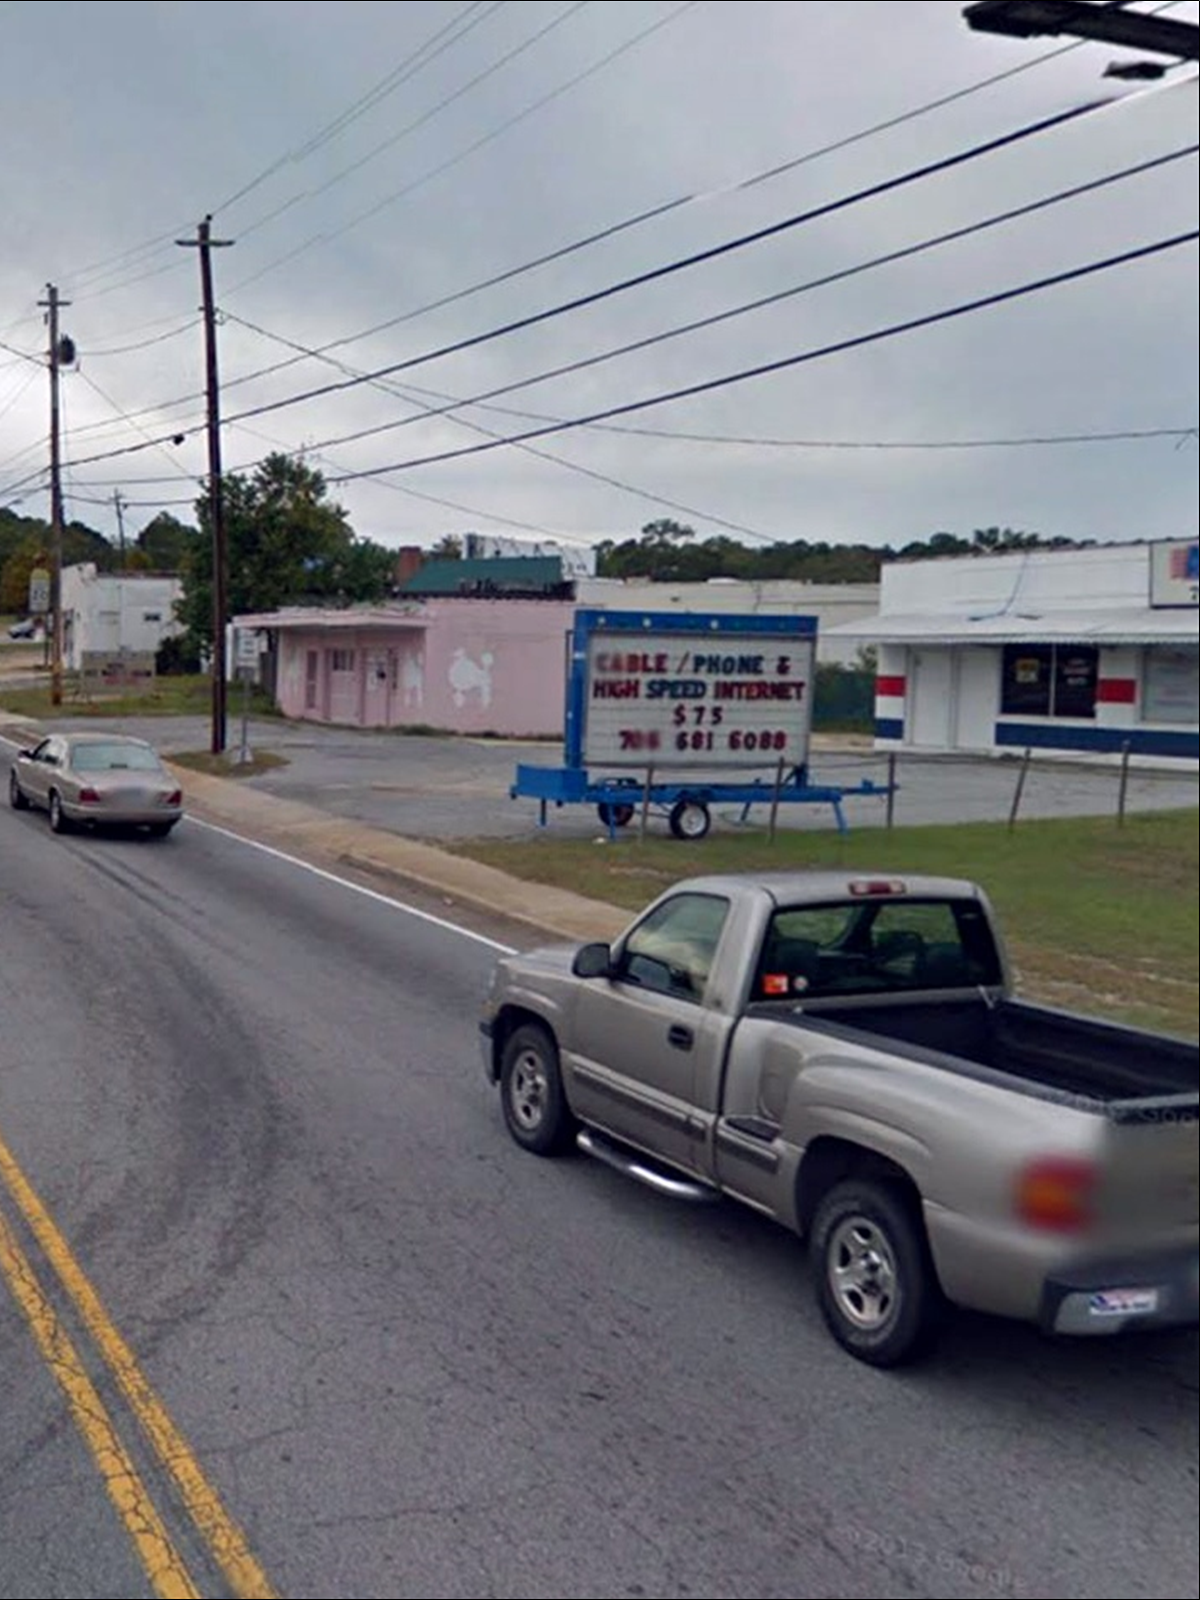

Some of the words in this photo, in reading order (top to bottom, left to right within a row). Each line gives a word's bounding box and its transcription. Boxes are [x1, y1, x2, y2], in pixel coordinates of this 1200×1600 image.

[595, 653, 668, 674] CABLE
[693, 655, 765, 675] PHONE
[776, 656, 791, 675] &
[593, 679, 640, 699] HIGH
[646, 679, 707, 699] SPEED
[713, 681, 805, 700] INTERNET
[676, 731, 714, 751] 681
